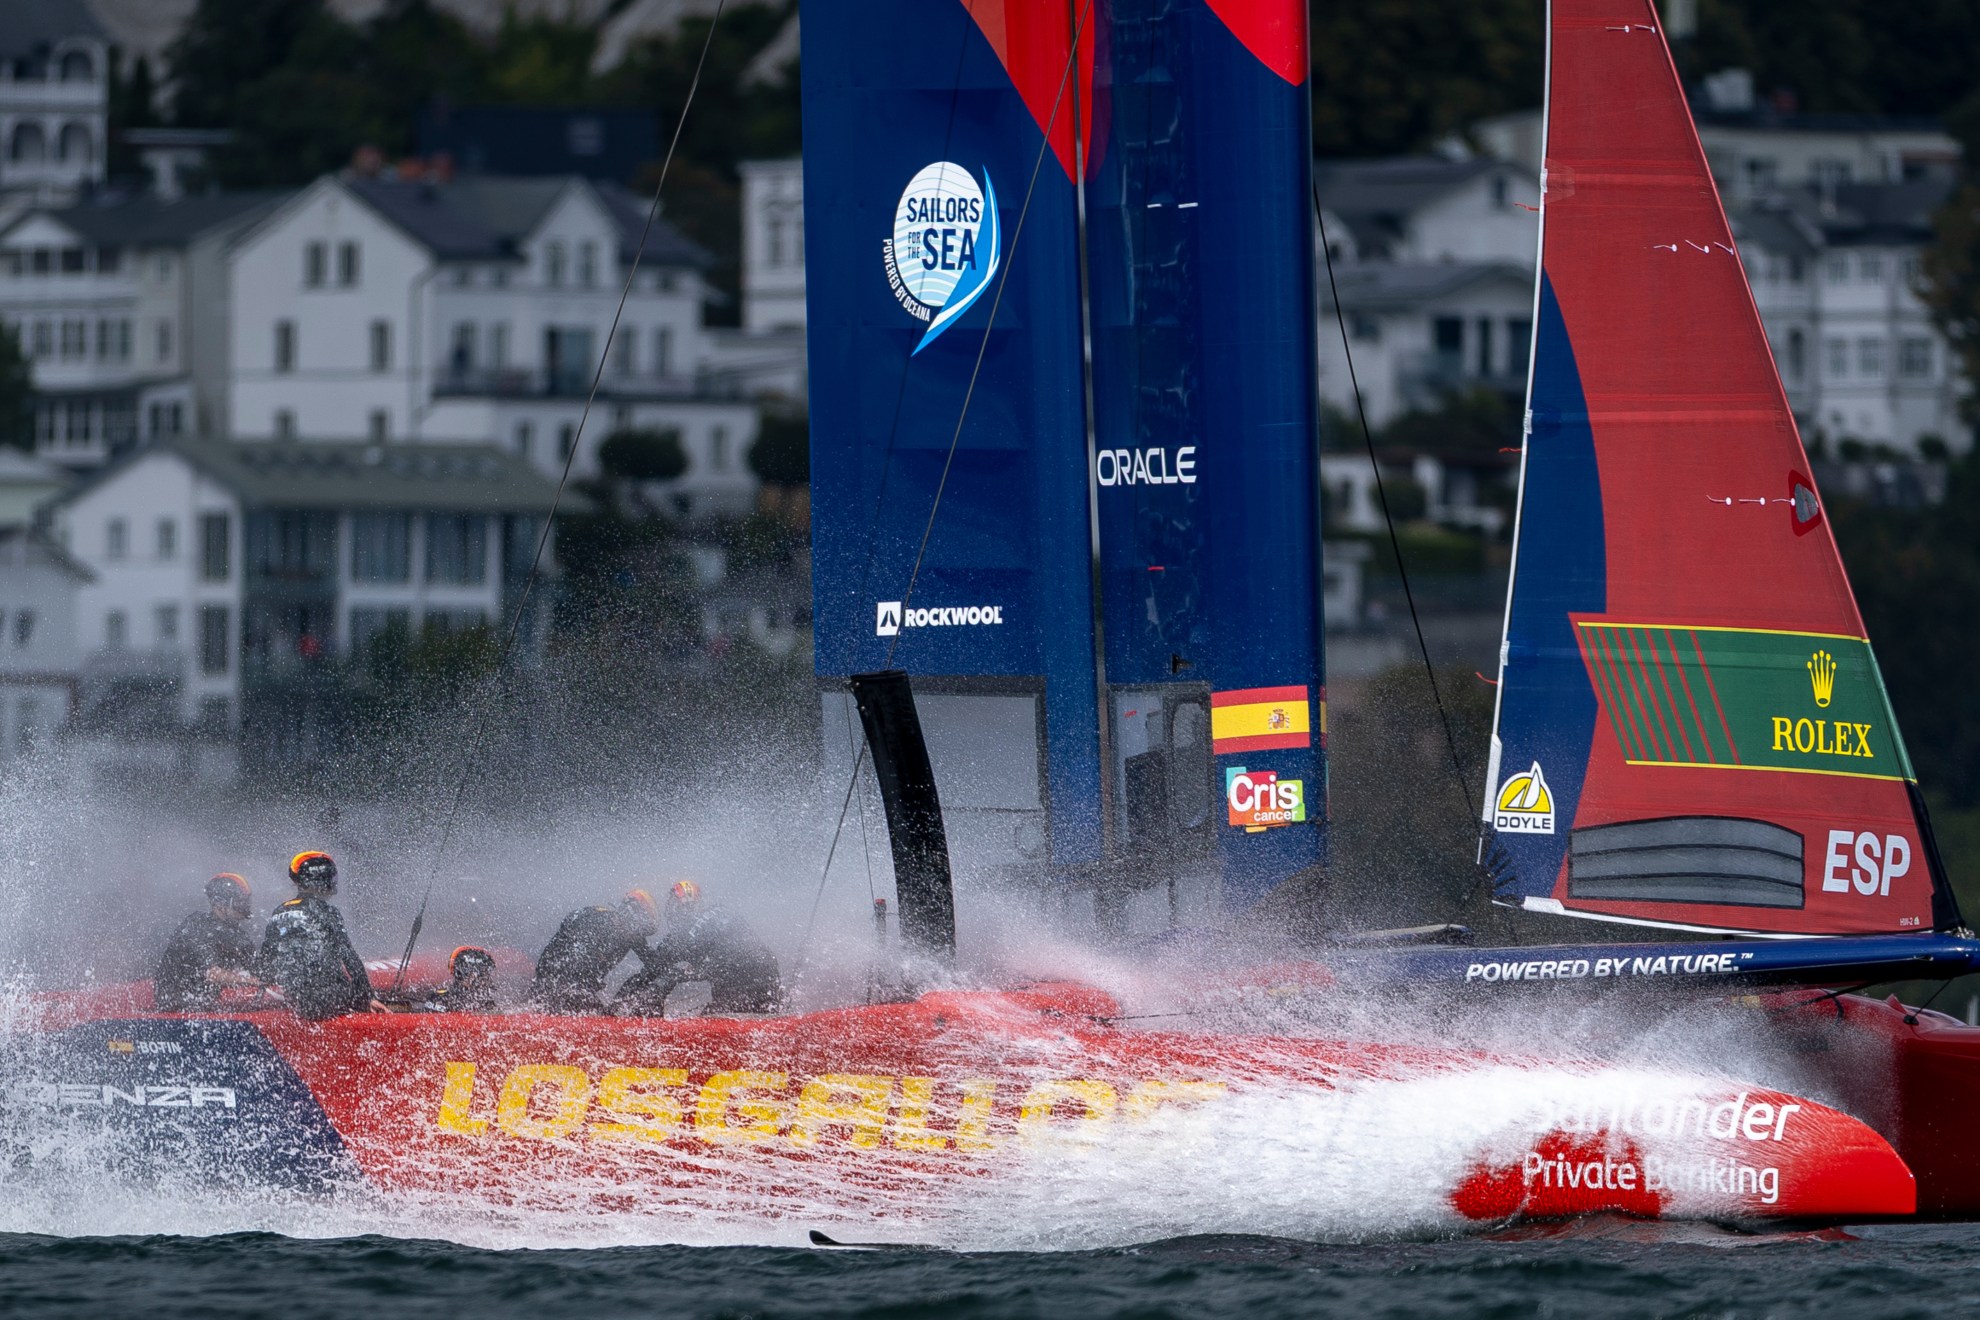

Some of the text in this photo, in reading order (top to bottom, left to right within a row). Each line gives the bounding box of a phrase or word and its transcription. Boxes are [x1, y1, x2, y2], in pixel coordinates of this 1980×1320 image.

[906, 197, 980, 223] SAILORS
[907, 231, 921, 244] FOR
[922, 228, 977, 271] SEA
[907, 246, 920, 259] THE
[883, 238, 931, 322] POWERED BY OCEANA
[1097, 446, 1197, 486] ORACLE
[904, 606, 1003, 627] ROCKWOOL
[1771, 716, 1874, 758] ROLEX
[1229, 774, 1300, 813] Cris
[1253, 810, 1298, 823] cancer
[1497, 816, 1551, 830] DOYLE
[1822, 829, 1911, 897] ESP
[1466, 959, 1589, 983] POWERED
[1594, 957, 1631, 977] BY
[140, 1041, 182, 1054] BOTIN
[1523, 1152, 1779, 1204] Private Banking
